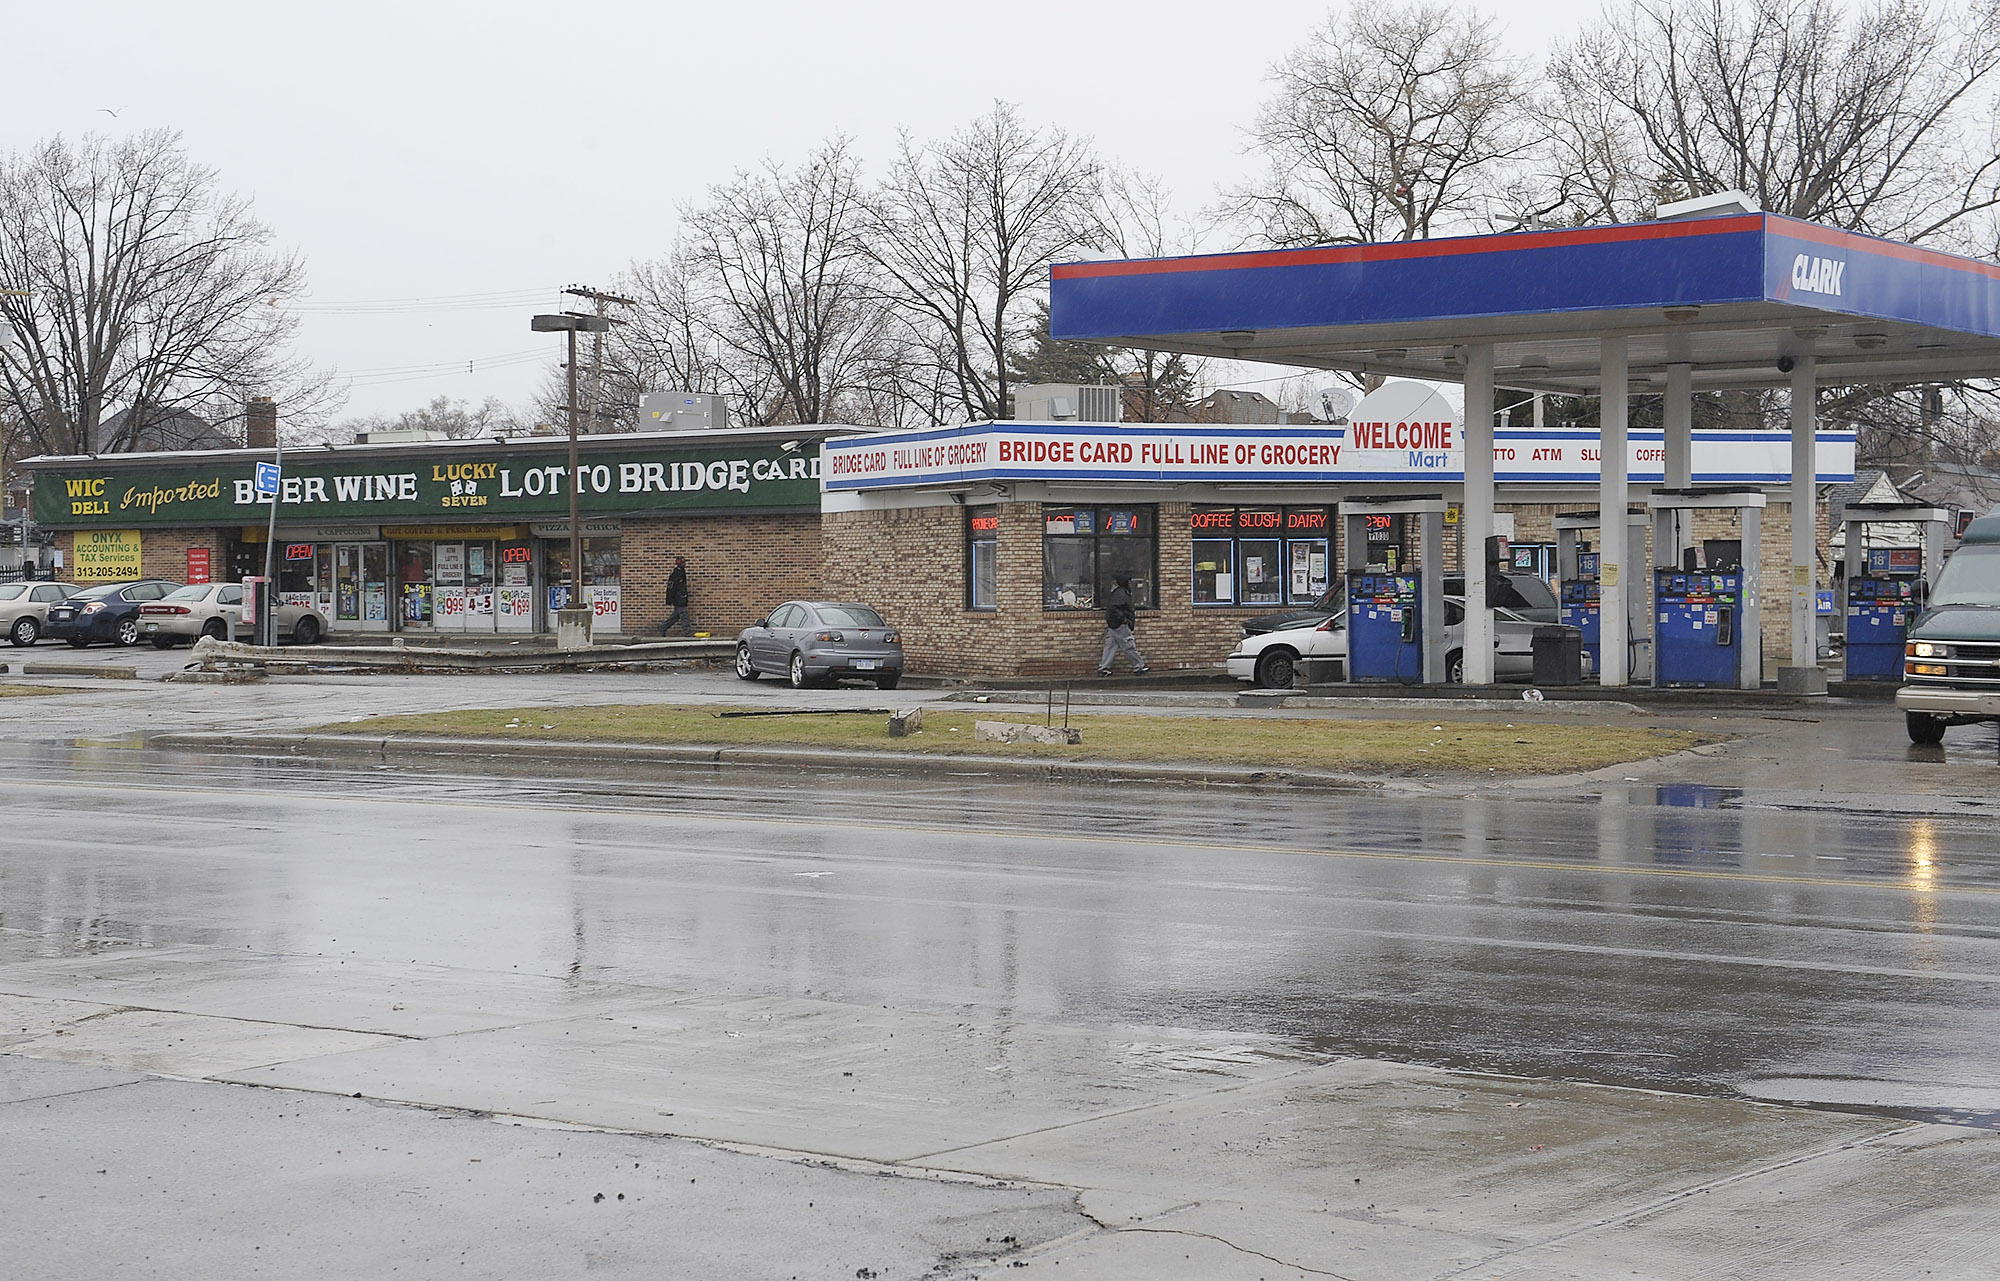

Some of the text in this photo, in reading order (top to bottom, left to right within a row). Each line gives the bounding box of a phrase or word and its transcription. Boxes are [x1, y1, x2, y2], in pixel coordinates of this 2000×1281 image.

[1791, 253, 1845, 296] CLARK
[1353, 422, 1452, 449] WELCOME
[833, 442, 988, 475] BRIDGE CARD FULL LINE OF GROCERY
[1000, 441, 1342, 465] BRIDGE CARD FULL LINE OF GROCERY
[1409, 451, 1448, 468] Mart
[1532, 448, 1562, 461] ATM
[432, 463, 499, 482] LUCKY
[499, 464, 612, 498] LOTTO
[618, 459, 751, 493] BRIDGE
[65, 479, 105, 497] WIC
[333, 473, 419, 502] WINE
[119, 477, 220, 514] Imported
[441, 495, 488, 508] SEVEN
[71, 501, 110, 515] DELI
[586, 523, 620, 531] CHICK
[1191, 513, 1328, 528] COFFEE SLUSH DAIRY
[92, 533, 122, 544] ONYX
[324, 527, 371, 536] CAPPUCCINO
[404, 527, 434, 535] COFFEE
[76, 543, 139, 553] ACCOUNTING &
[287, 545, 313, 559] OPEN
[502, 547, 531, 563] OPEN
[80, 553, 135, 562] TAX Services
[77, 566, 139, 577] 313-205-2494
[404, 584, 410, 593] 2
[469, 598, 476, 610] 4
[484, 595, 491, 609] 5
[594, 600, 618, 616] 500
